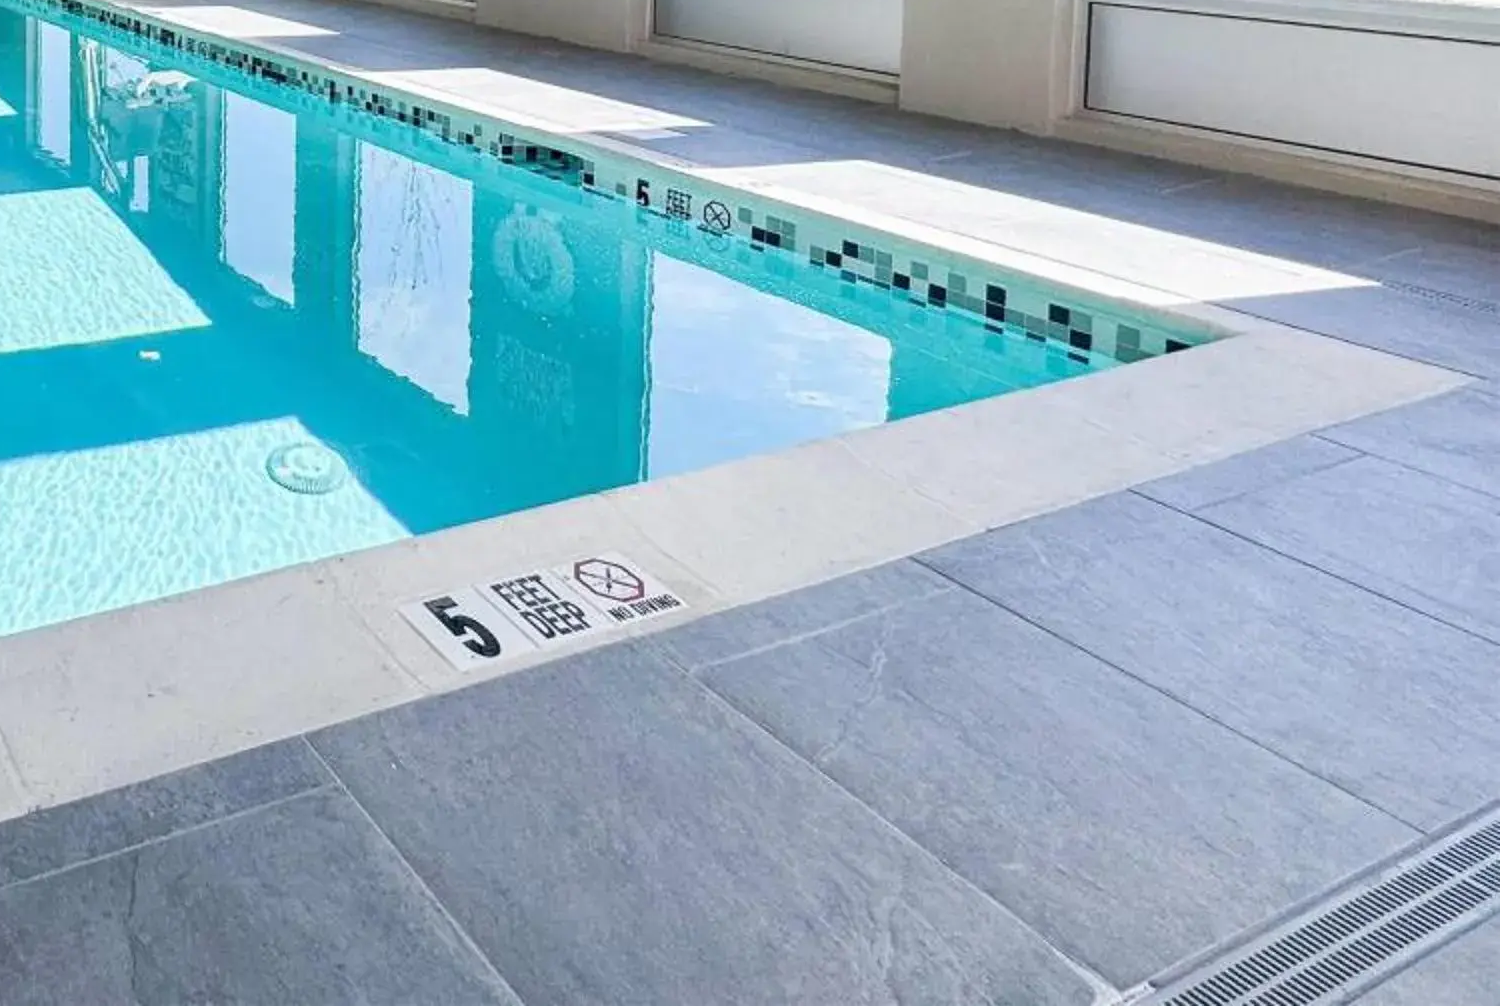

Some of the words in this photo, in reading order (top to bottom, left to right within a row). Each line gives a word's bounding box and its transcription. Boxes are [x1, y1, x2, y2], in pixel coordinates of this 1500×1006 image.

[636, 178, 650, 206] 5
[667, 188, 692, 209] FEET
[490, 574, 561, 611] FEET
[607, 605, 631, 622] NO
[631, 593, 682, 617] DIVING
[423, 595, 502, 658] 5
[518, 600, 591, 639] DEEP
